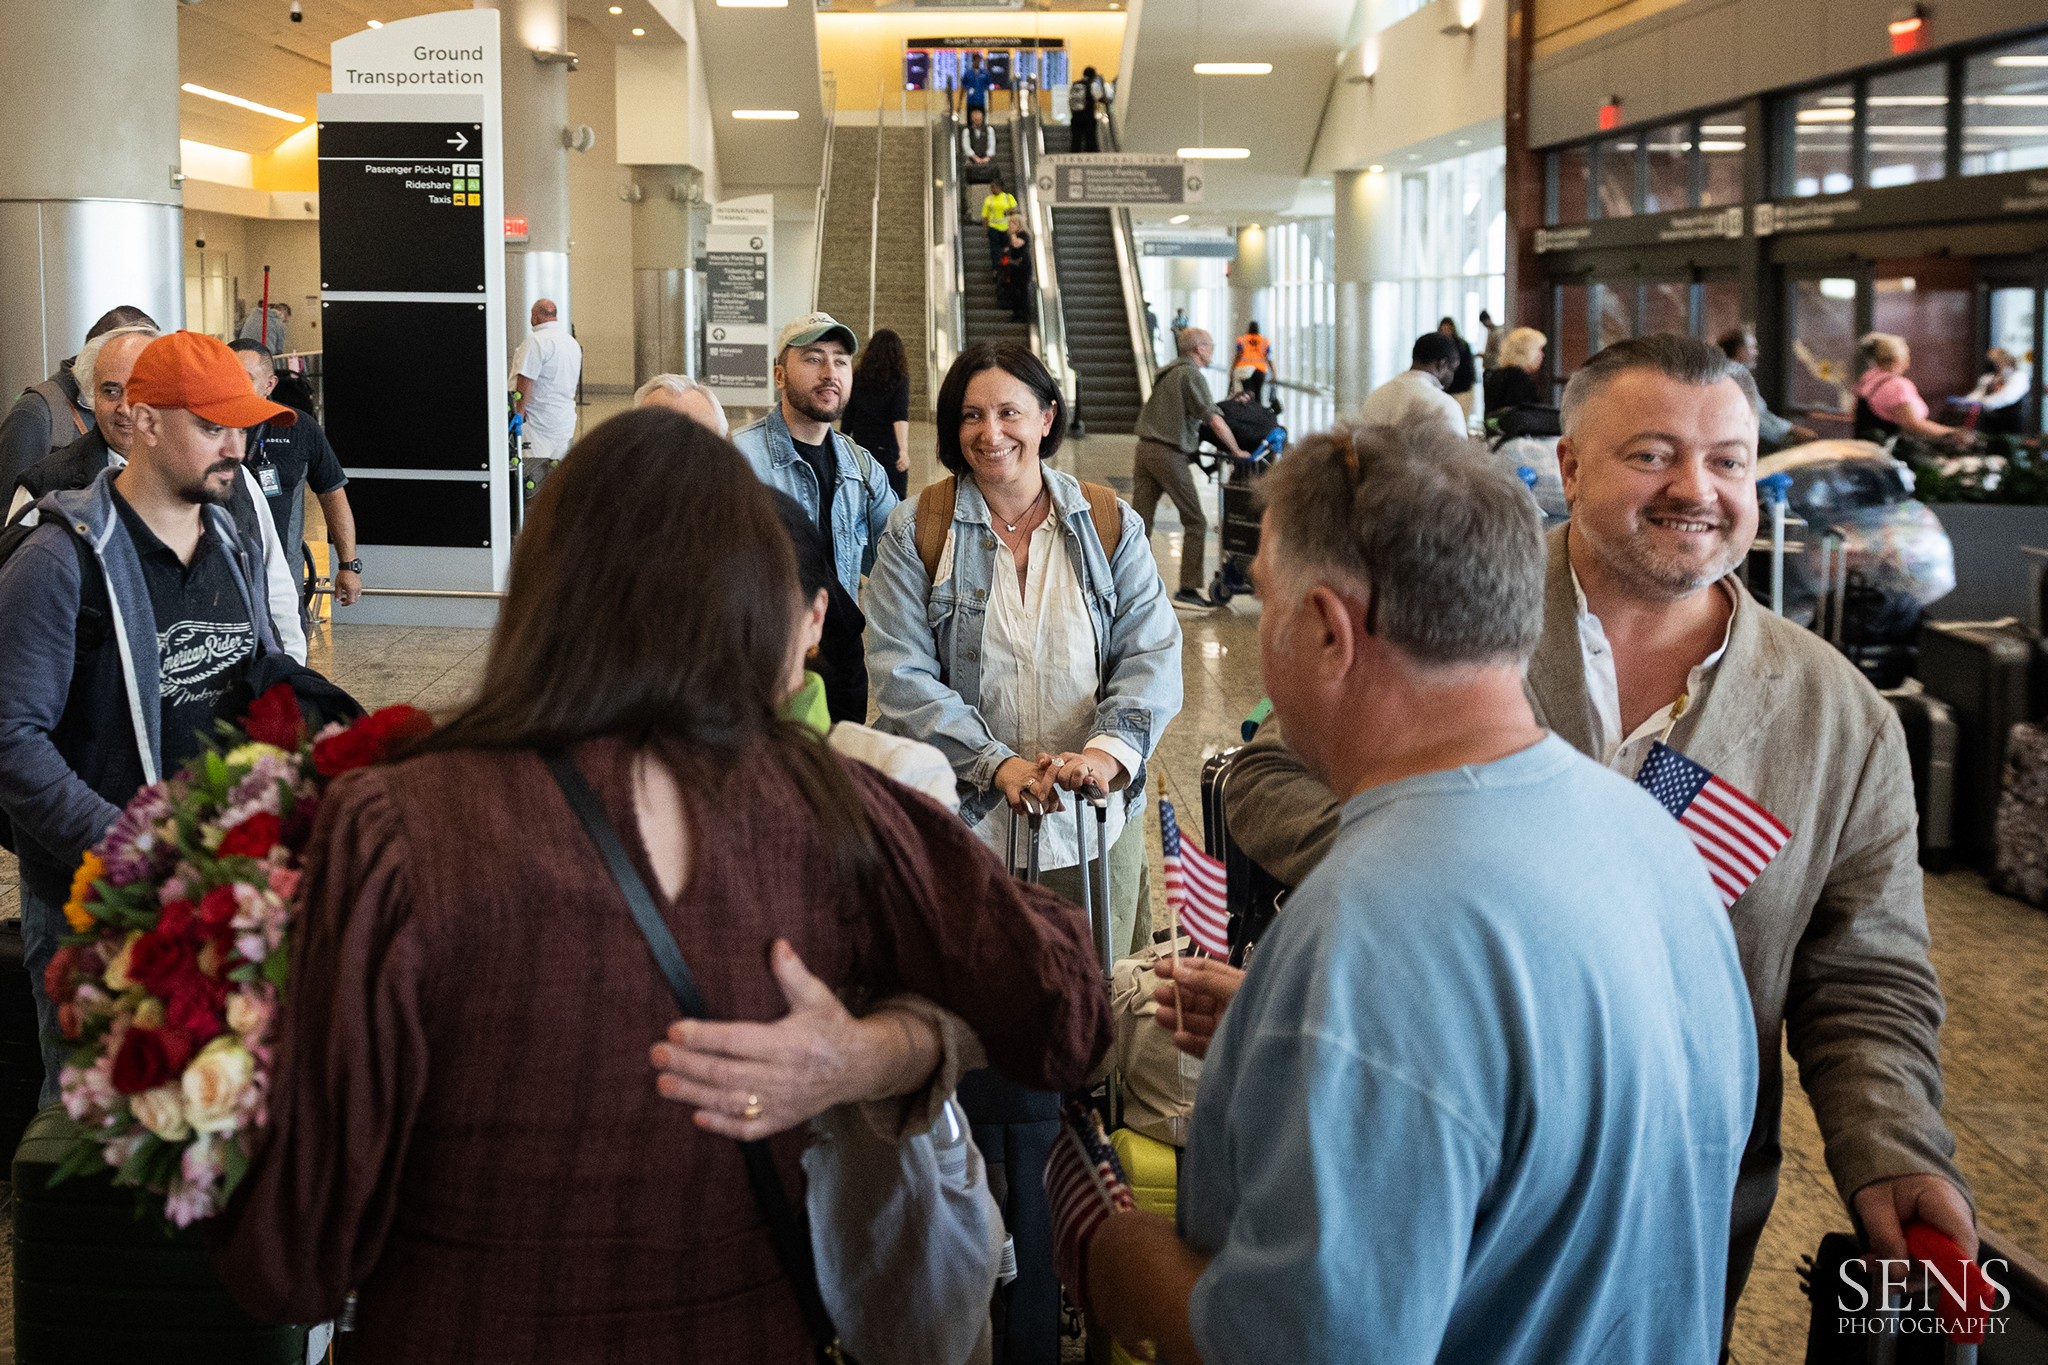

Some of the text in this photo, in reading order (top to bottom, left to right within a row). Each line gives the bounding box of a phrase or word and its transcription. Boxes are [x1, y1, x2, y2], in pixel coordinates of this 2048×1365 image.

[414, 46, 483, 61] Ground
[347, 69, 484, 86] Transportation
[365, 164, 412, 176] Passenger
[414, 165, 451, 176] Pick-Up
[405, 180, 451, 189] Rideshare
[428, 195, 451, 204] Taxis
[160, 634, 243, 676] merican Rider
